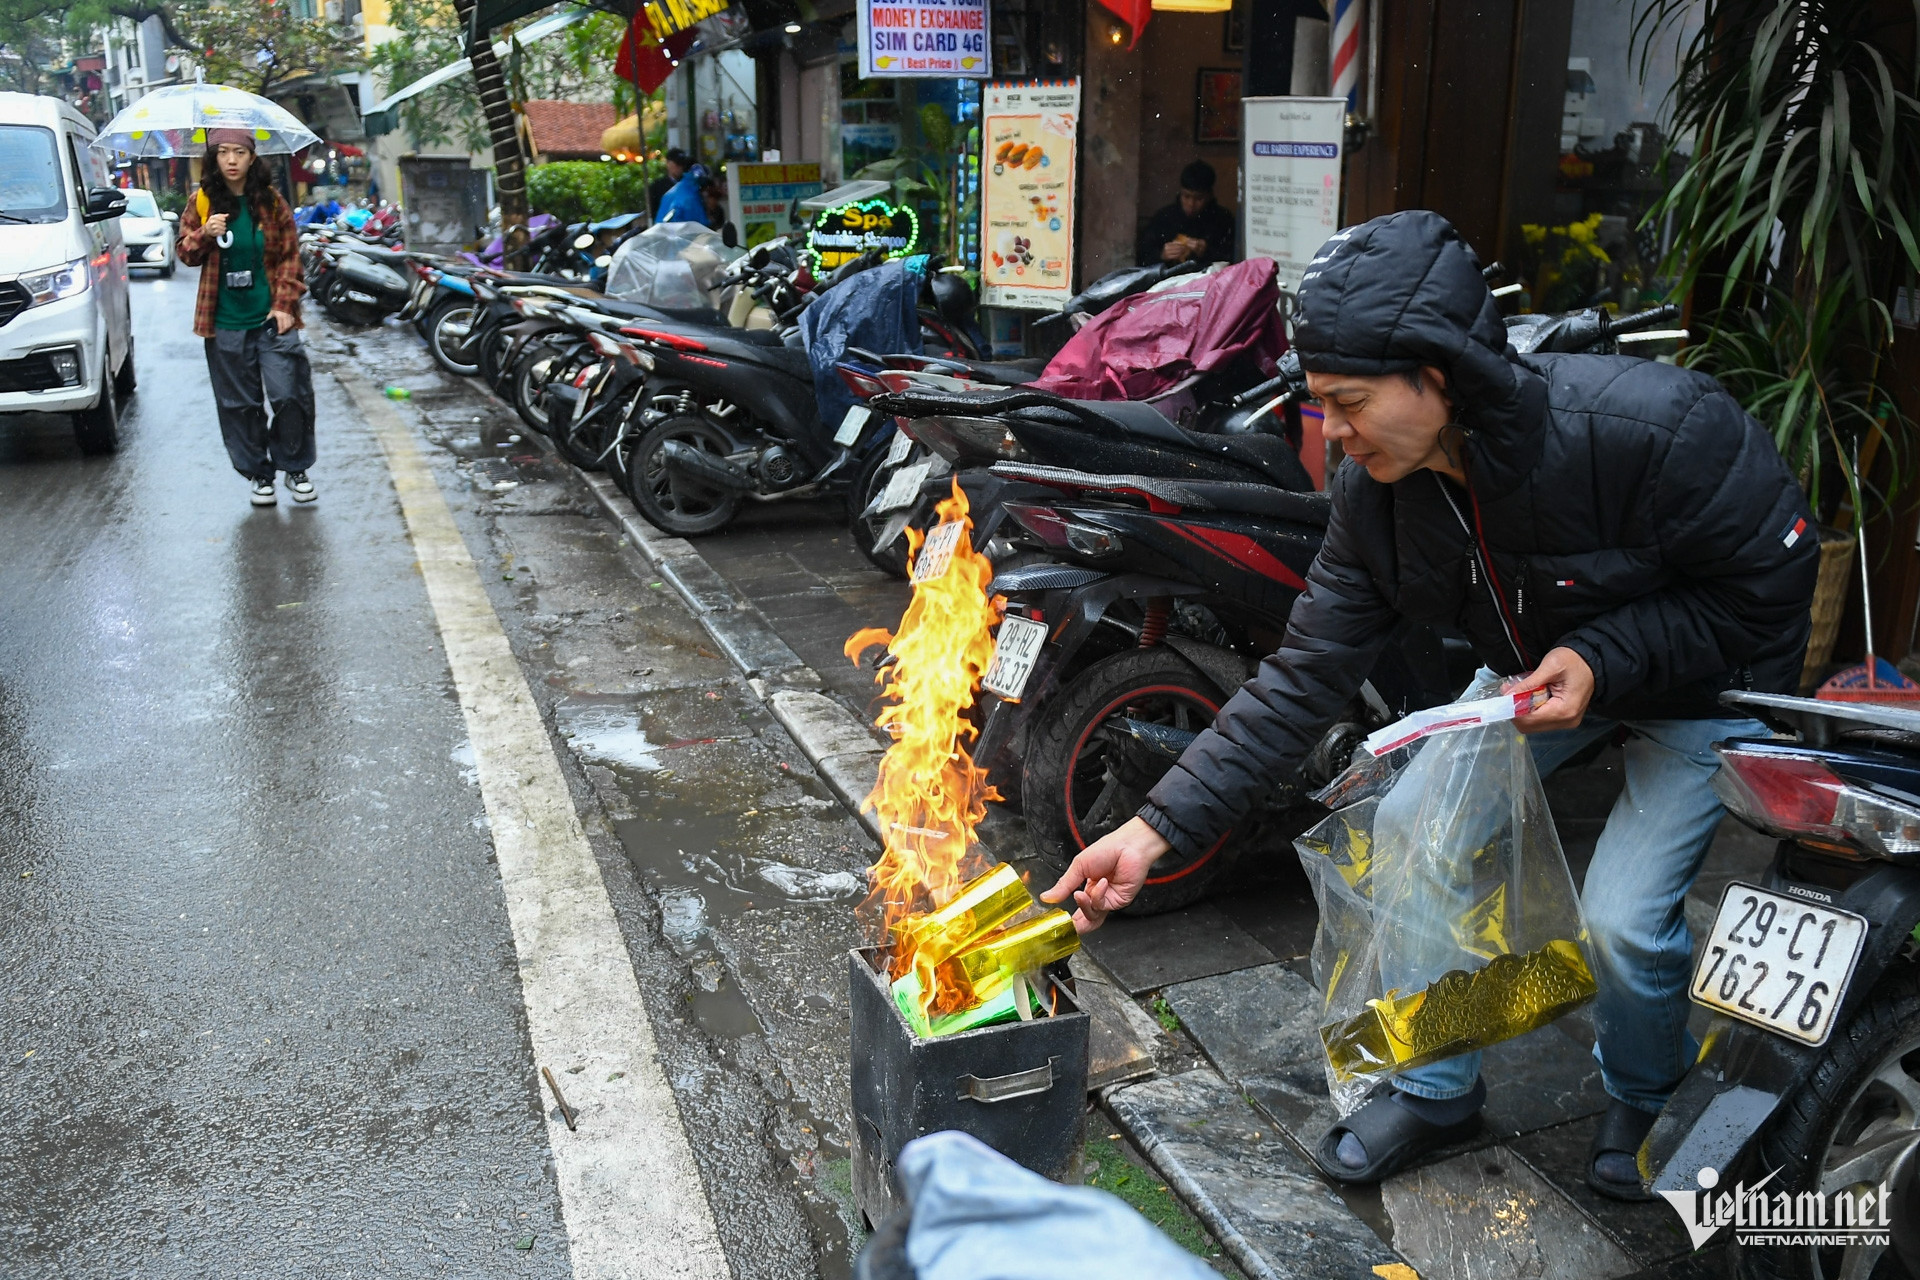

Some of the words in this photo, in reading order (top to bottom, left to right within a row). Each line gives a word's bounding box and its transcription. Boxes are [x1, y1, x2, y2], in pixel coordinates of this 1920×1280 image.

[873, 8, 915, 27] MONEY
[920, 9, 983, 29] EXCHANGE
[875, 32, 907, 50] SIM
[913, 33, 957, 51] CARD
[963, 33, 983, 52] 4G
[929, 58, 952, 69] Price
[1294, 145, 1334, 157] EXPERIENCE
[842, 208, 893, 230] Spa
[813, 230, 864, 251] Nourishing
[864, 231, 907, 251] Shampoo
[1000, 622, 1038, 658] 29-H2
[1788, 885, 1833, 903] HONDA
[1728, 896, 1838, 969] 29-C1
[1699, 945, 1829, 1031] 762.76
